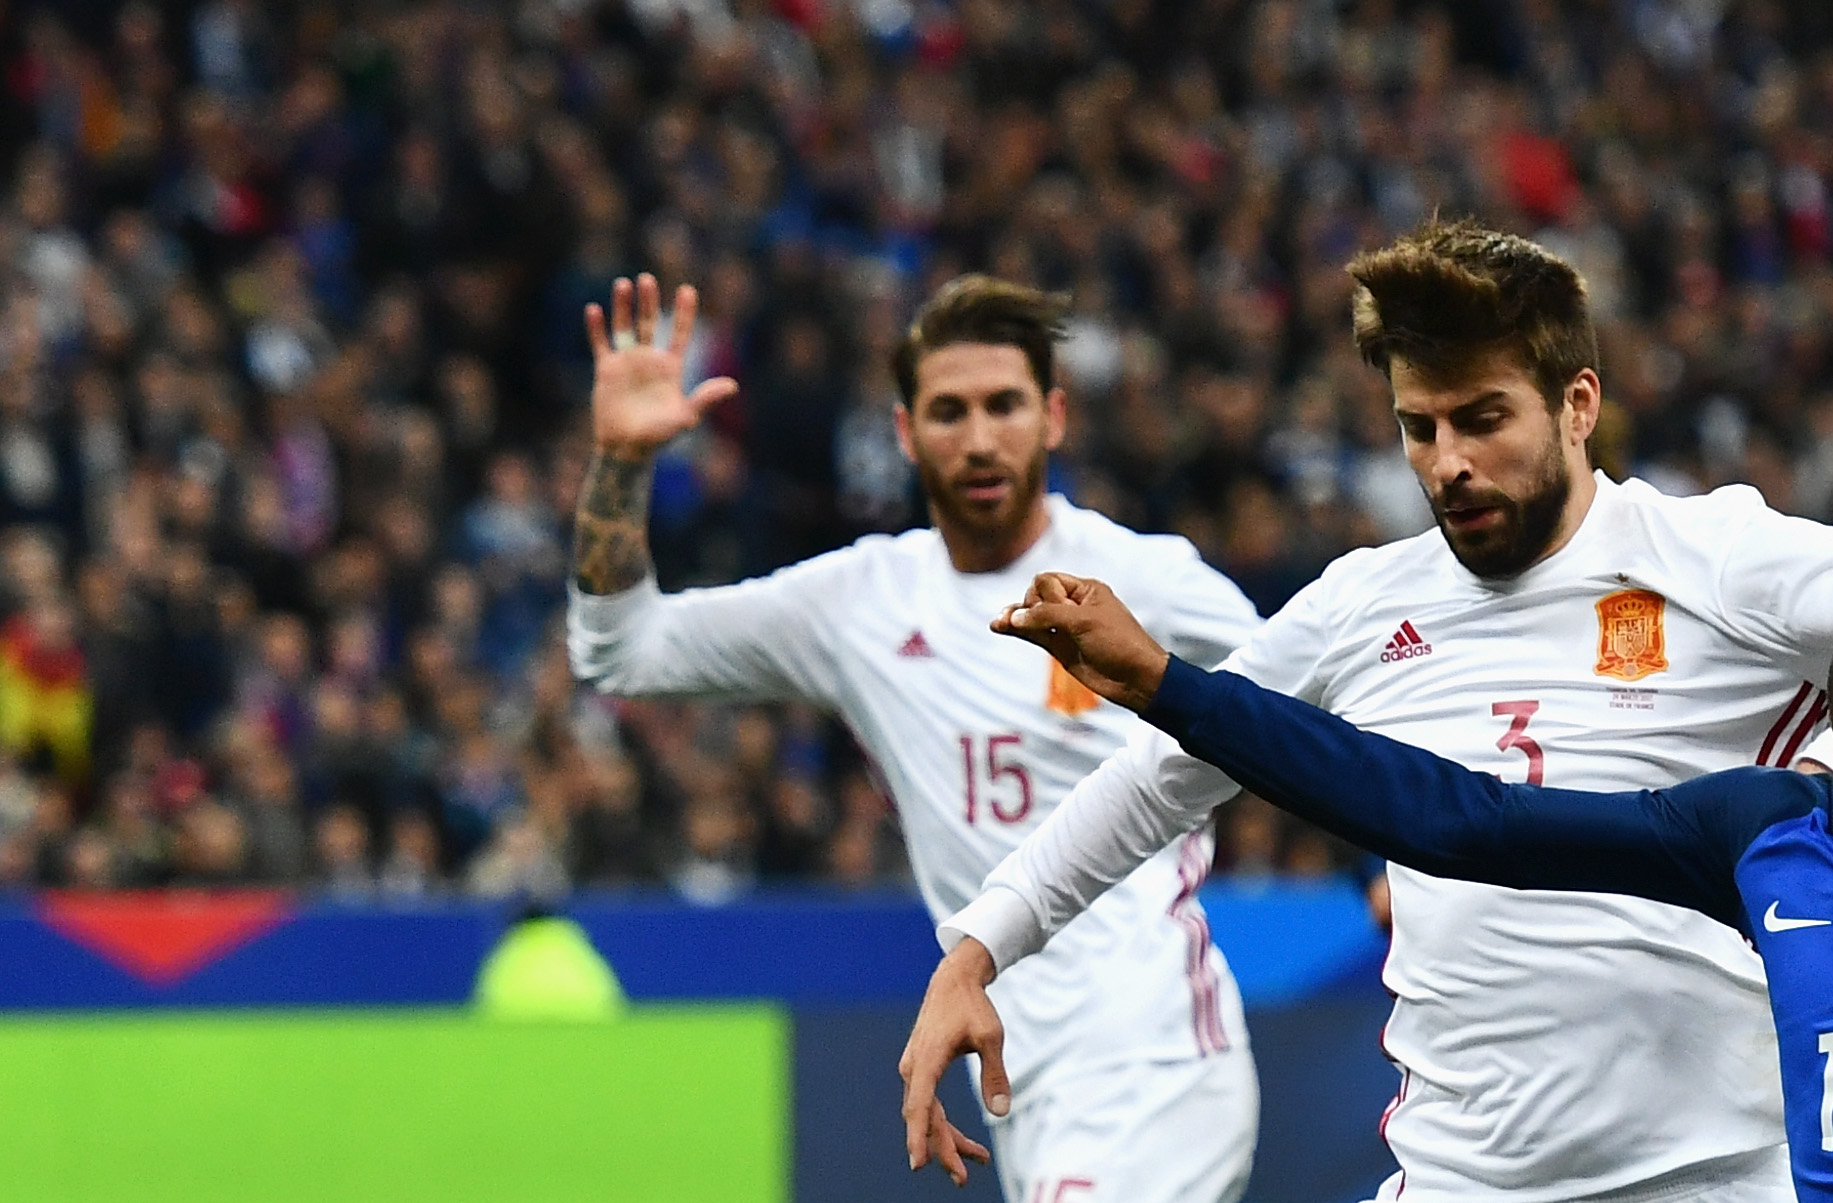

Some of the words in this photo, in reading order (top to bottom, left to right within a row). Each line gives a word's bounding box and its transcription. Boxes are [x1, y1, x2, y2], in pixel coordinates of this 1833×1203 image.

[1380, 643, 1432, 664] adidas
[959, 735, 1033, 825] 15
[1491, 699, 1545, 787] 3
